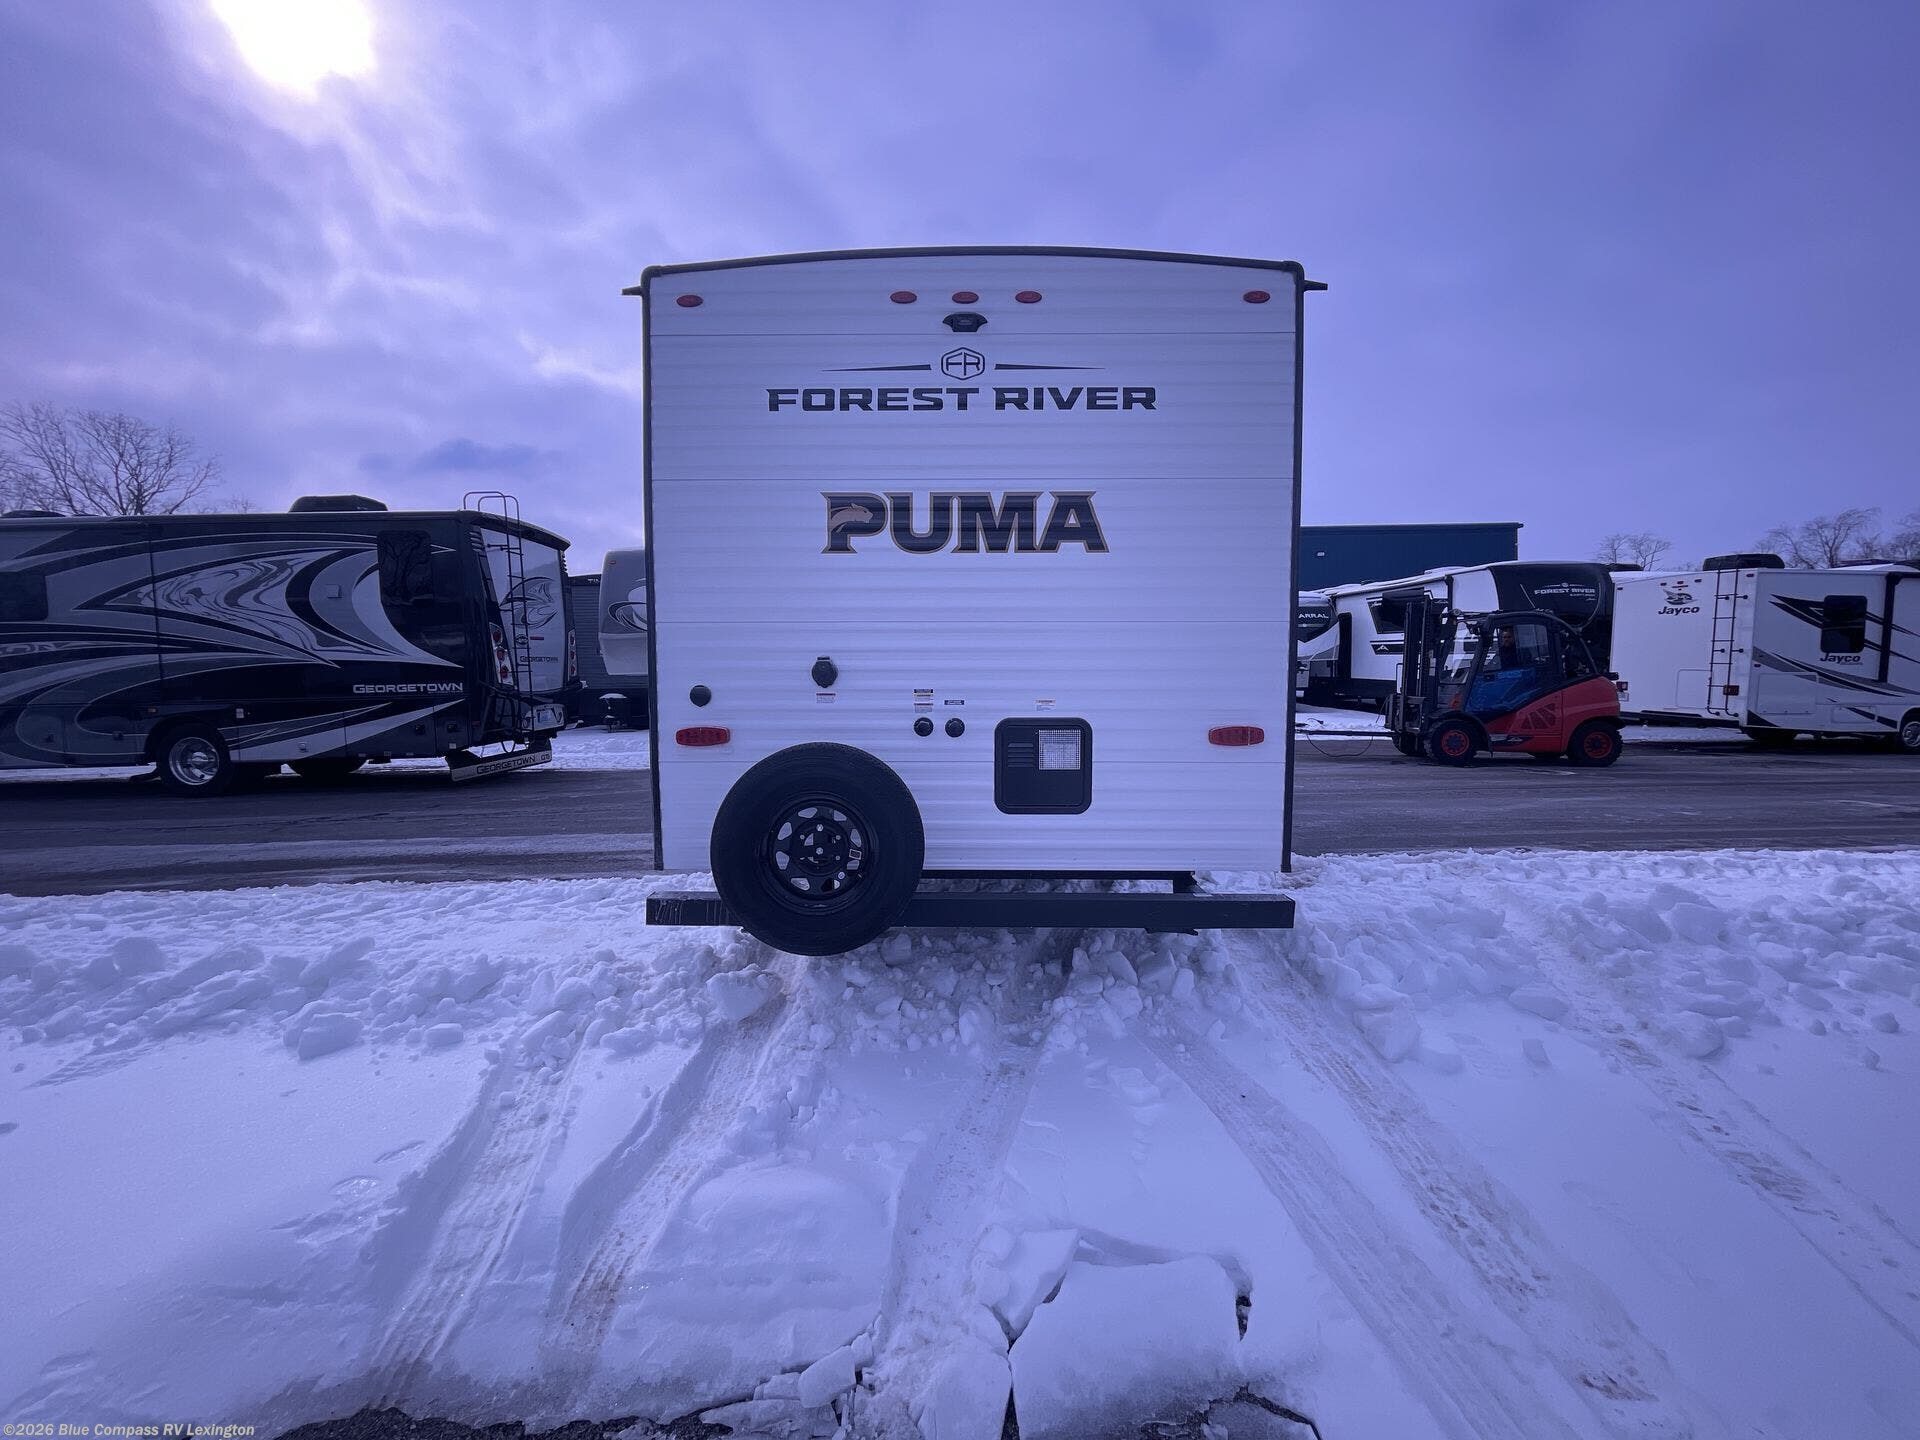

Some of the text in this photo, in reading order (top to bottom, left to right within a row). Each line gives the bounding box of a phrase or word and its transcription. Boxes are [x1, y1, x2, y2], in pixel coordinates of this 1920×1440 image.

[944, 350, 983, 377] FR
[766, 387, 1157, 412] FOREST RIVER
[820, 491, 1110, 554] PUMA
[1658, 606, 1700, 616] Jayco
[1820, 652, 1861, 664] Jayco
[353, 682, 463, 694] GEORGETOWN
[477, 754, 536, 775] GEORGETOWN
